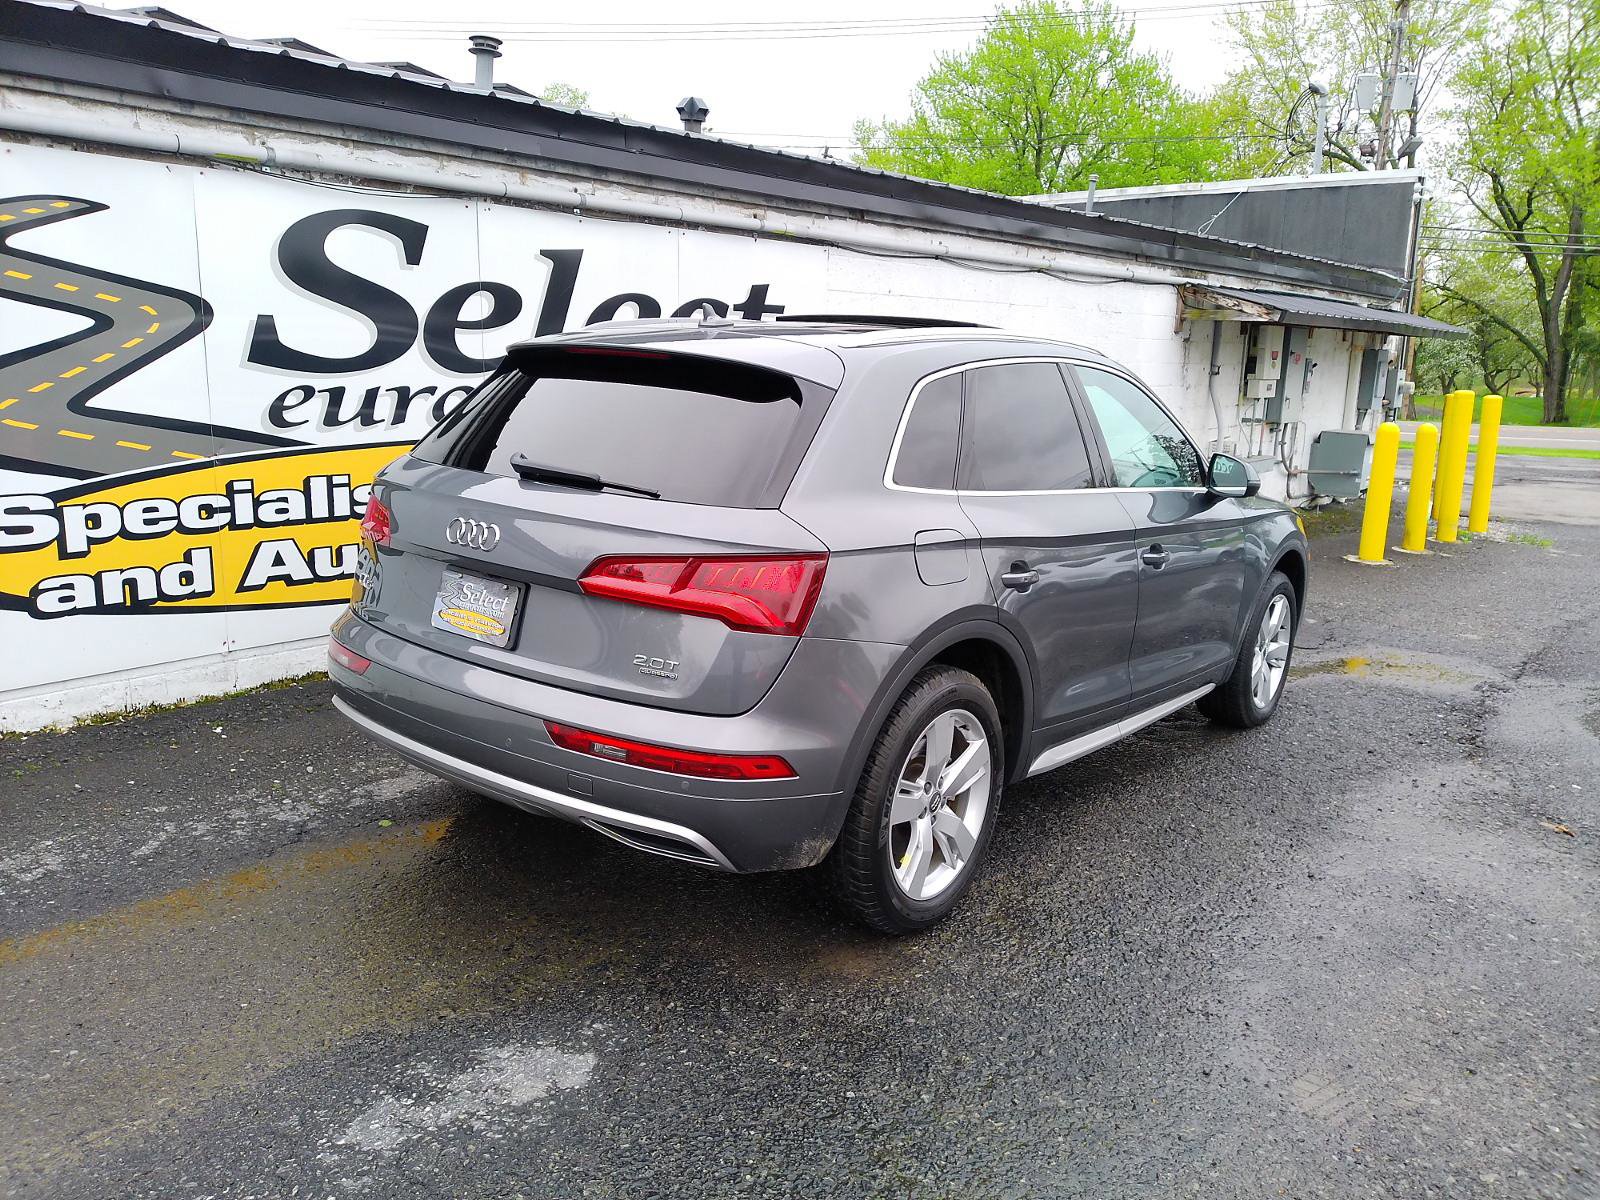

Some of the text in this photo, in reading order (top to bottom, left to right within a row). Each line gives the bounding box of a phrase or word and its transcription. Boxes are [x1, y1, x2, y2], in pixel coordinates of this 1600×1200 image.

[35, 539, 360, 613] and Au
[460, 583, 510, 611] Select
[633, 654, 680, 670] 2.0T
